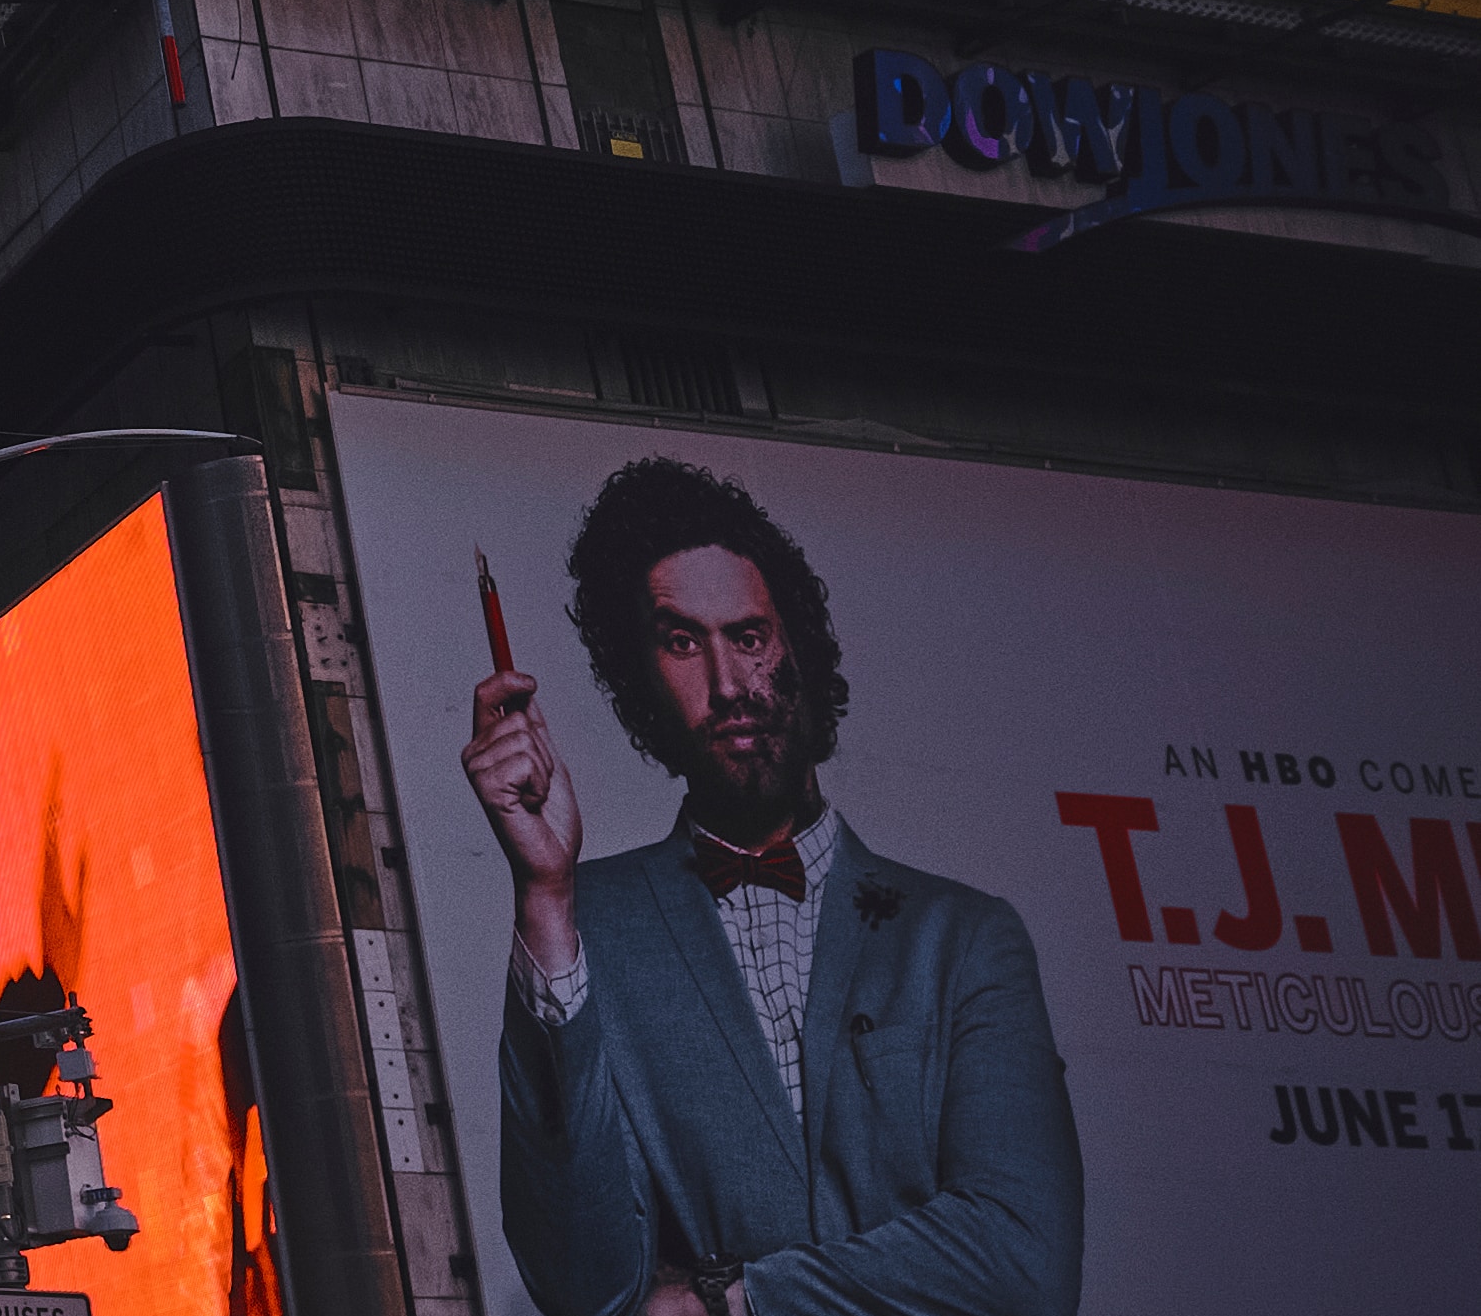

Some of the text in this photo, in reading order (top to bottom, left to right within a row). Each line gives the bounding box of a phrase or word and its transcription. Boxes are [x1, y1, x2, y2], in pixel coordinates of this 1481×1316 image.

[854, 47, 1451, 228] DOW JONES
[1163, 744, 1220, 781] AN
[1239, 750, 1336, 791] HBO
[1055, 790, 1336, 954] T.J.
[1268, 1084, 1429, 1150] JUNE
